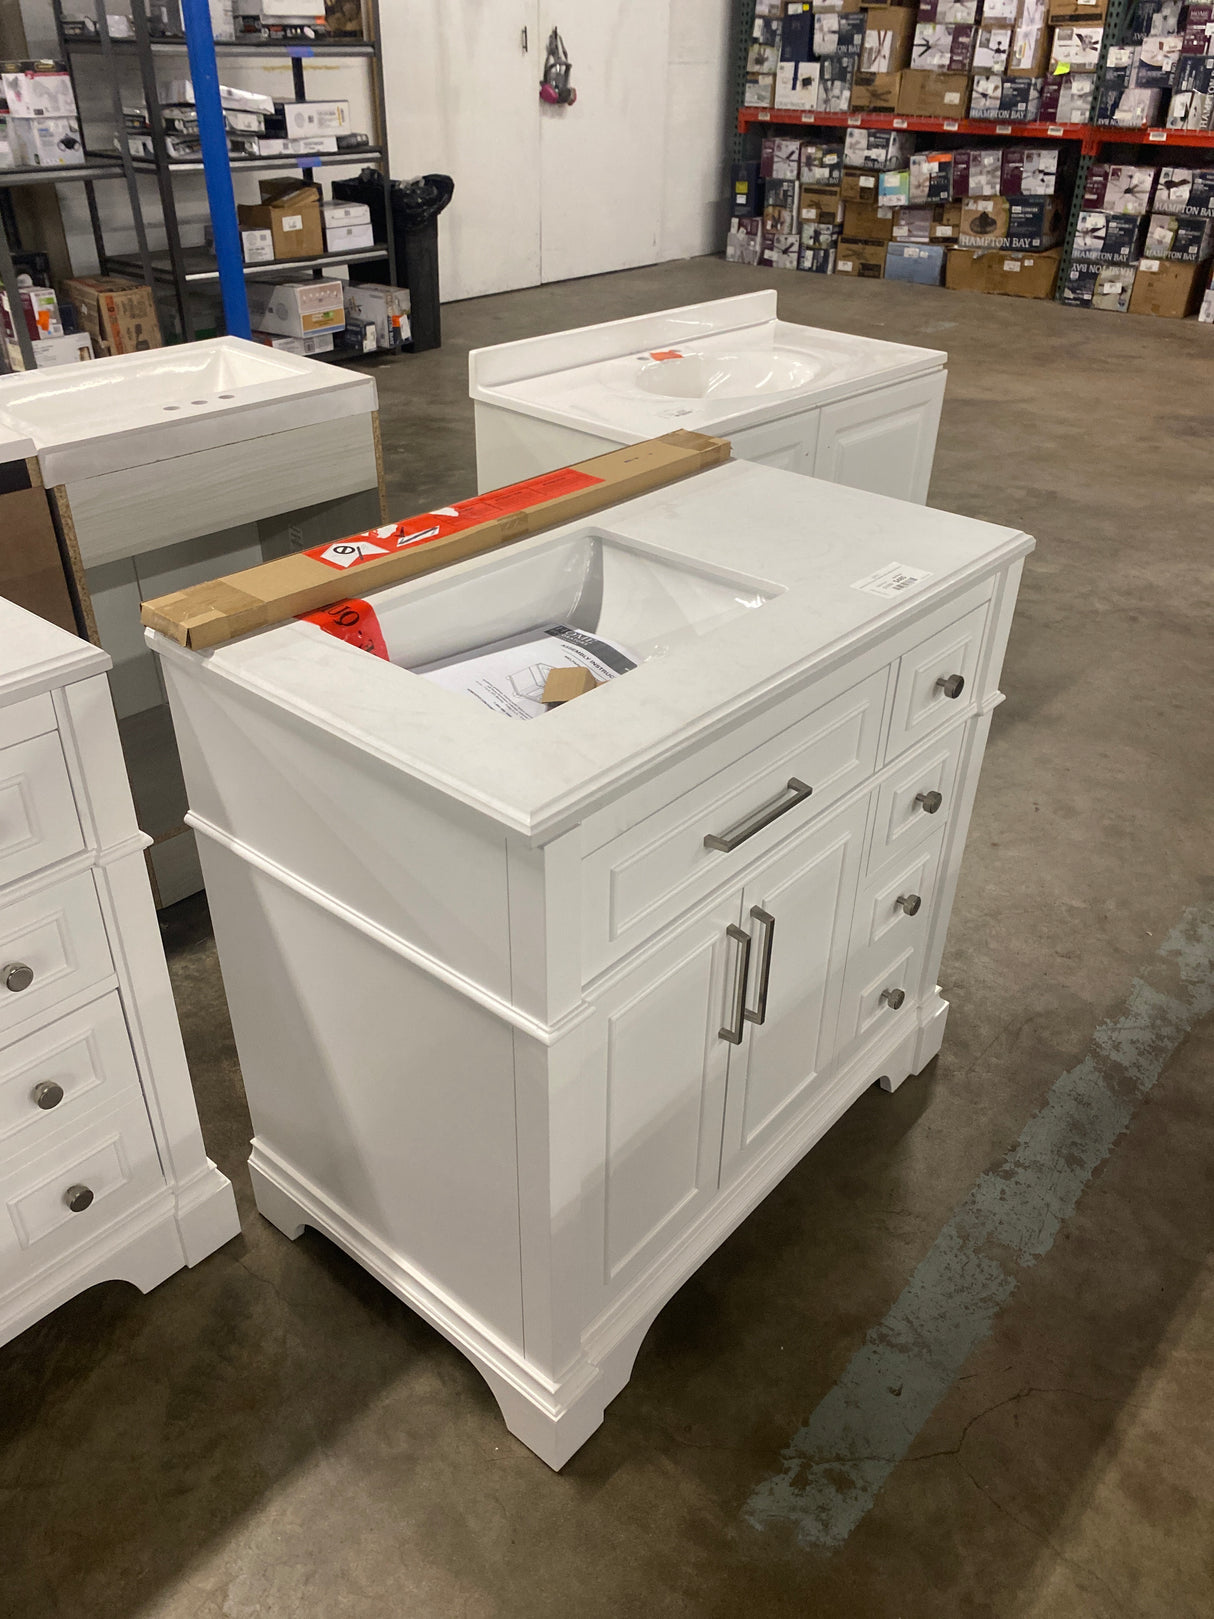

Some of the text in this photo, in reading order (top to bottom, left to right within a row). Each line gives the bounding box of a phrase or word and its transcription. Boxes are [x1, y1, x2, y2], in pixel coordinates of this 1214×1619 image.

[1156, 201, 1199, 215] HAMPTON
[961, 234, 1031, 248] HAMPTON BAY
[1072, 250, 1128, 262] HAMPTON BAY
[1146, 250, 1198, 261] HAMPTON BAY
